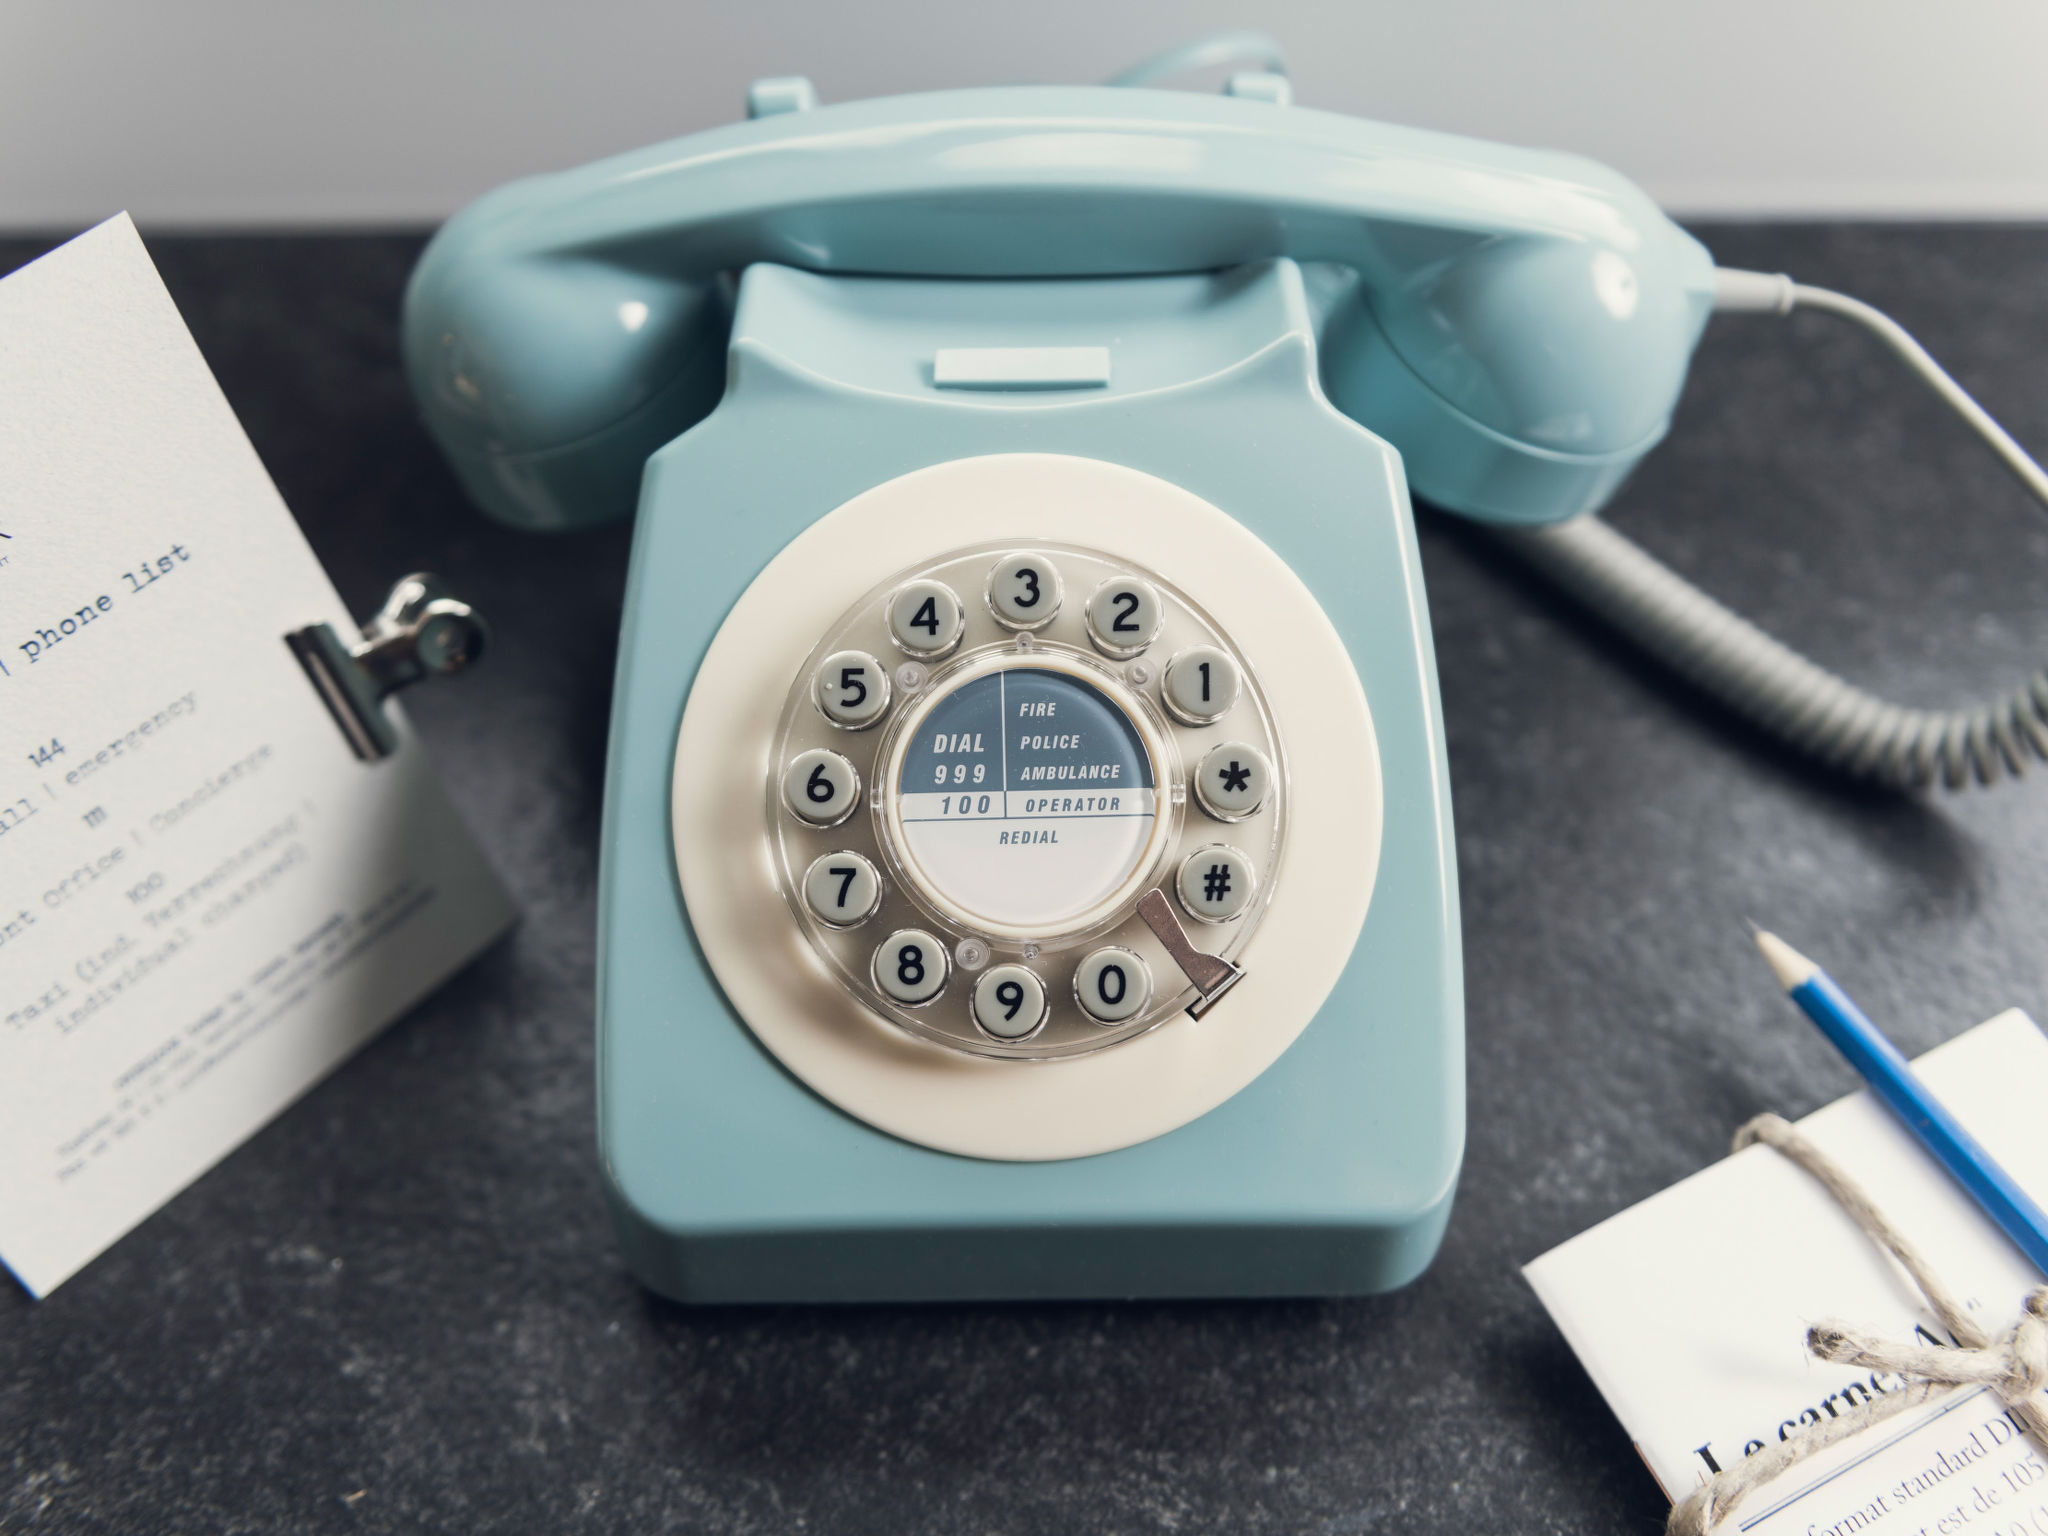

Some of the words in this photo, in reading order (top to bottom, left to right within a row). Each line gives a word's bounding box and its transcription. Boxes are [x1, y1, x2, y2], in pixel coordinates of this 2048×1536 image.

[19, 593, 113, 664] phone
[122, 543, 191, 593] list
[1014, 569, 1040, 608] 3
[910, 597, 939, 636] 4
[1112, 592, 1140, 633] 2
[839, 667, 867, 708] 5
[1198, 662, 1210, 702] 1
[1019, 702, 1057, 718] FIRE
[28, 737, 65, 768] 144
[65, 691, 195, 785] emergency
[933, 733, 985, 754] DIAL
[1020, 734, 1080, 750] POLICE
[806, 763, 835, 803] 6
[934, 763, 986, 785] 999
[1020, 764, 1121, 781] AMBULANCE
[942, 794, 991, 815] 100
[1025, 796, 1120, 813] OPERATOR
[999, 829, 1059, 845] REDIAL
[43, 846, 126, 908] Office
[126, 872, 165, 904] 100
[829, 867, 857, 908] 7
[1203, 863, 1232, 902] #
[897, 944, 926, 986] 8
[1098, 964, 1127, 1005] 0
[5, 981, 70, 1030] Taxi
[996, 981, 1024, 1022] 9
[1778, 1370, 1908, 1442] carne
[1892, 1432, 1988, 1505] standard
[1937, 1507, 1970, 1535] est
[1972, 1485, 2002, 1514] de
